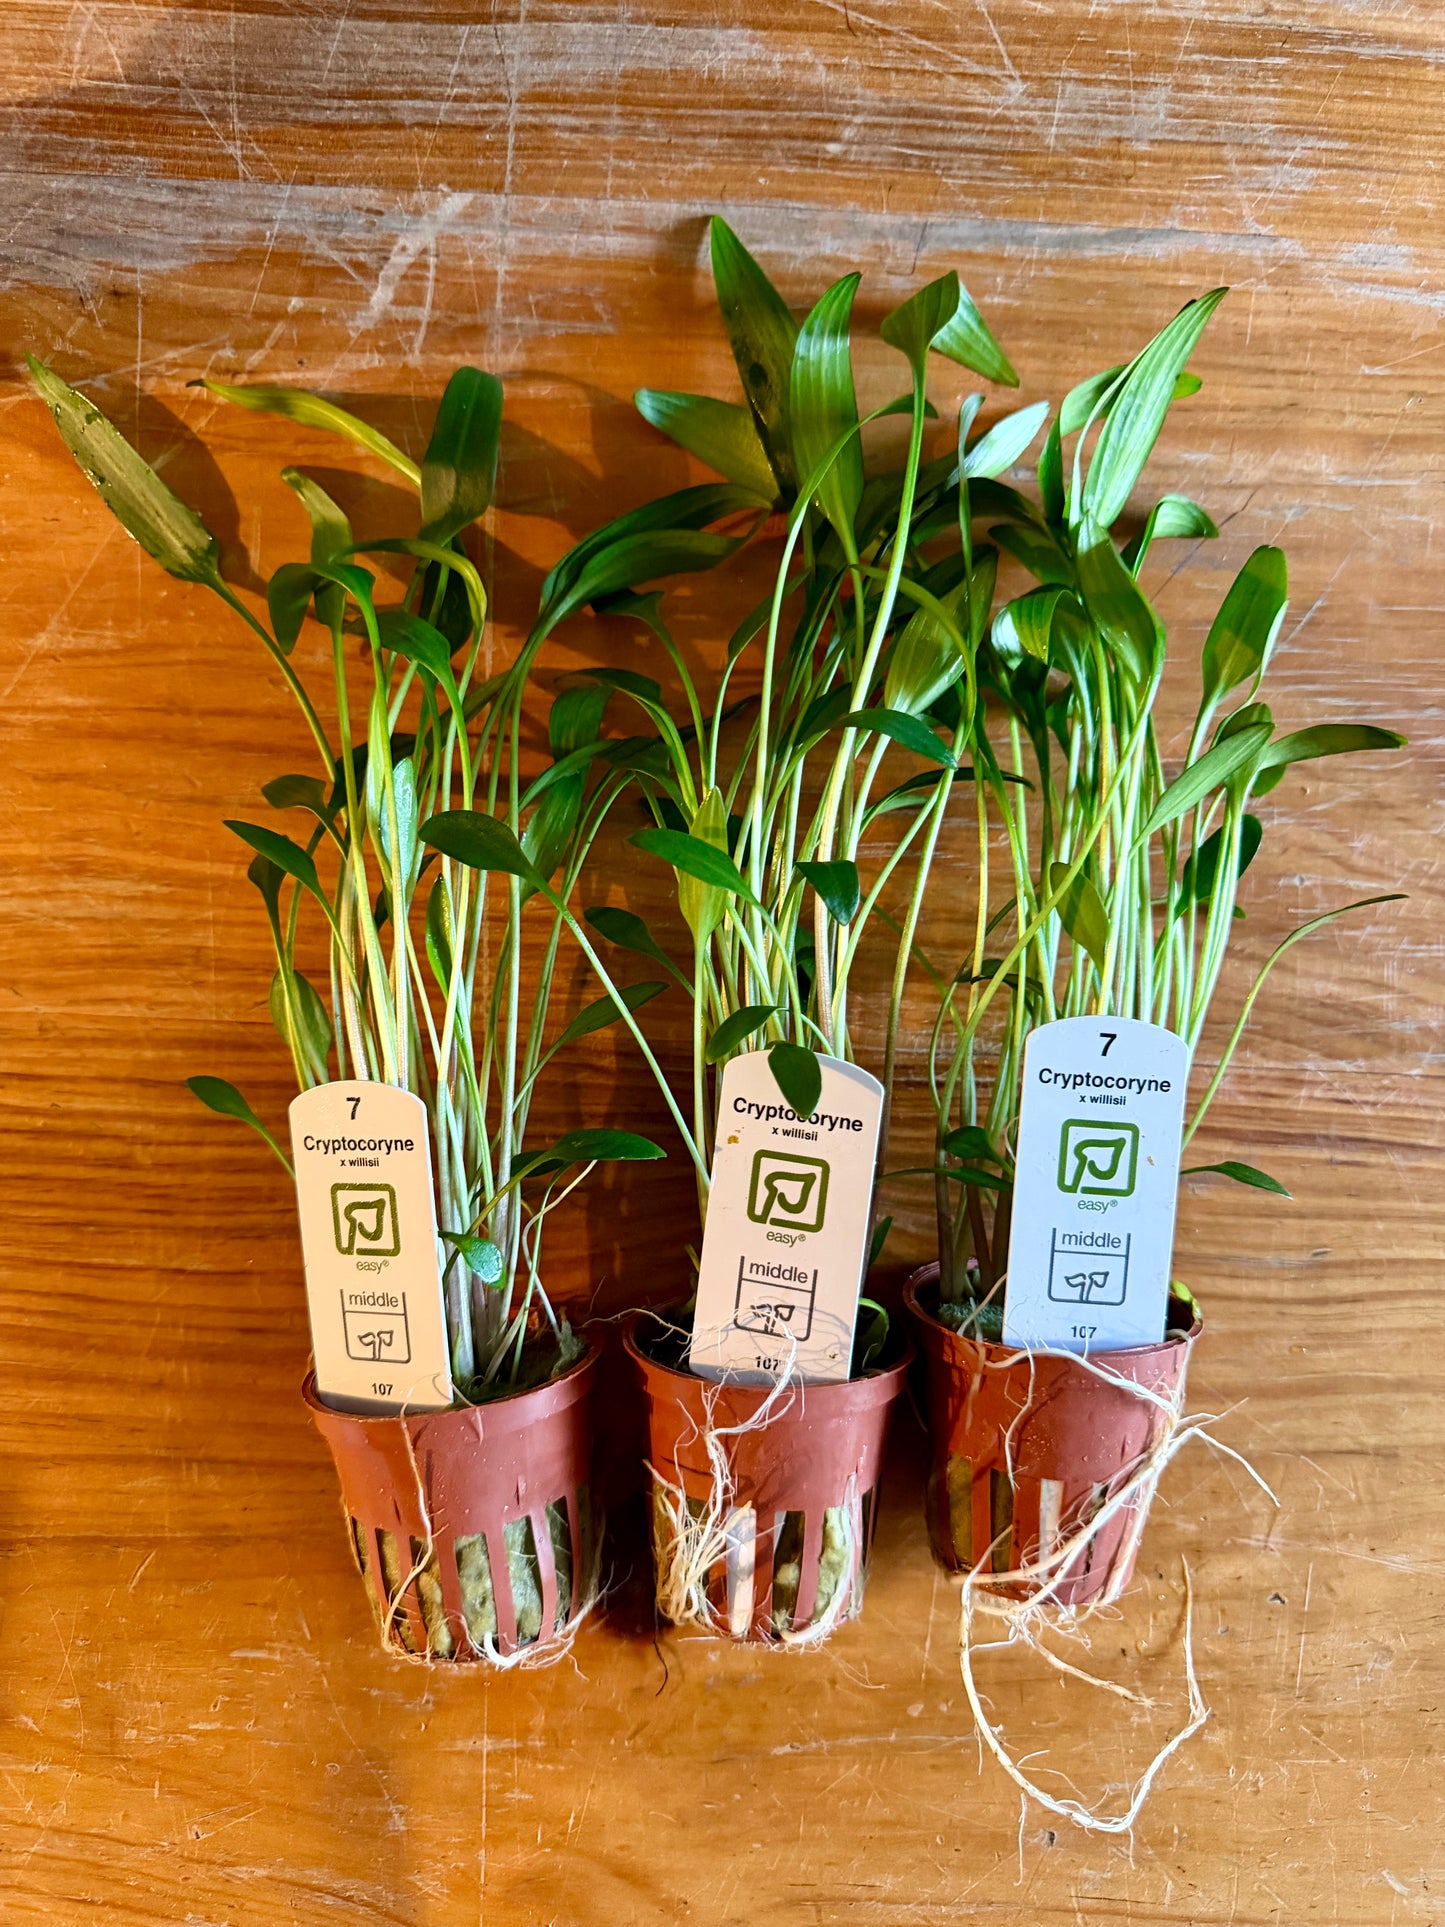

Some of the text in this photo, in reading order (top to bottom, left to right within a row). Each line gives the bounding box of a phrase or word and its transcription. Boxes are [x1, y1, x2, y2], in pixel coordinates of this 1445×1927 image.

[1099, 1032, 1117, 1057] 7
[1038, 1067, 1172, 1095] Cryptocoryne
[1079, 1094, 1127, 1106] x willisii
[346, 1096, 361, 1121] 7
[771, 1127, 819, 1142] x willisii
[303, 1135, 415, 1156] Cryptocoryne
[348, 1157, 380, 1168] willisii
[1061, 1231, 1122, 1249] middle
[749, 1261, 808, 1284] middle
[349, 1292, 399, 1308] middle
[1070, 1325, 1097, 1340] 107
[755, 1355, 781, 1371] 107
[371, 1383, 393, 1396] 107
